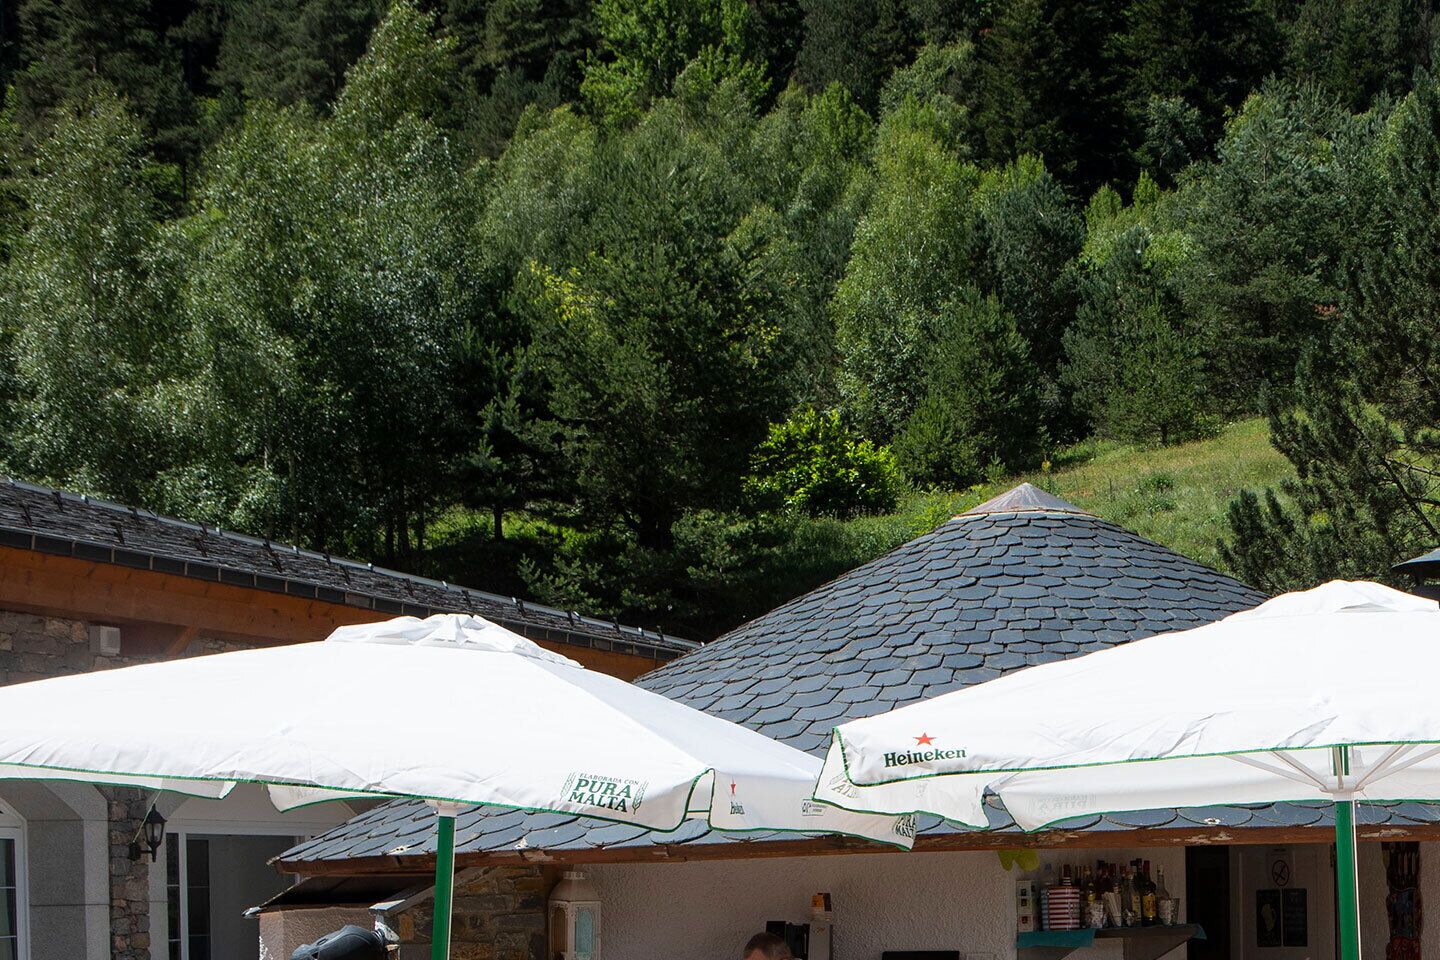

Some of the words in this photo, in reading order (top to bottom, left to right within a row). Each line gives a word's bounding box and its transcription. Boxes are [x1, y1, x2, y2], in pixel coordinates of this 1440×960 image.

[884, 748, 967, 768] Heineken
[579, 772, 622, 784] ELABORADA
[574, 778, 632, 799] PURA
[568, 791, 628, 813] MALTA
